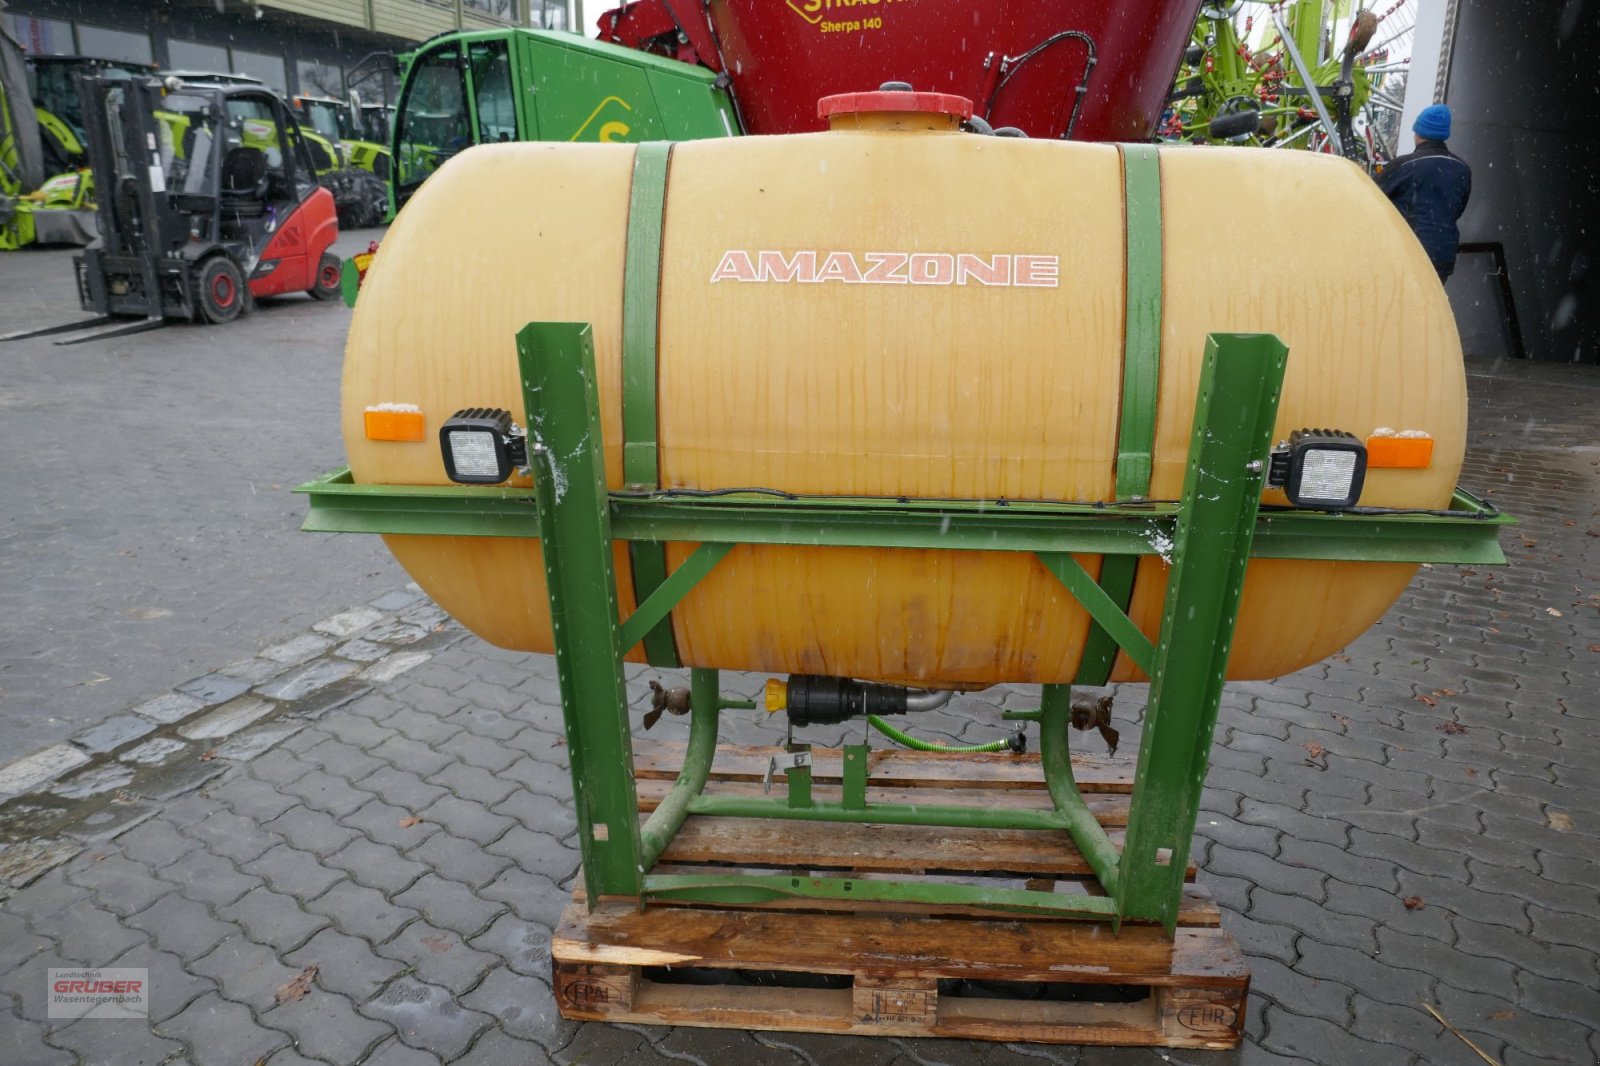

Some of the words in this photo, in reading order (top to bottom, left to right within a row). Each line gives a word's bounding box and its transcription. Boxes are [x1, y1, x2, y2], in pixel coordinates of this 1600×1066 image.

[820, 20, 860, 34] Sherpa
[863, 17, 882, 30] 140
[709, 250, 1060, 288] AMAZONE
